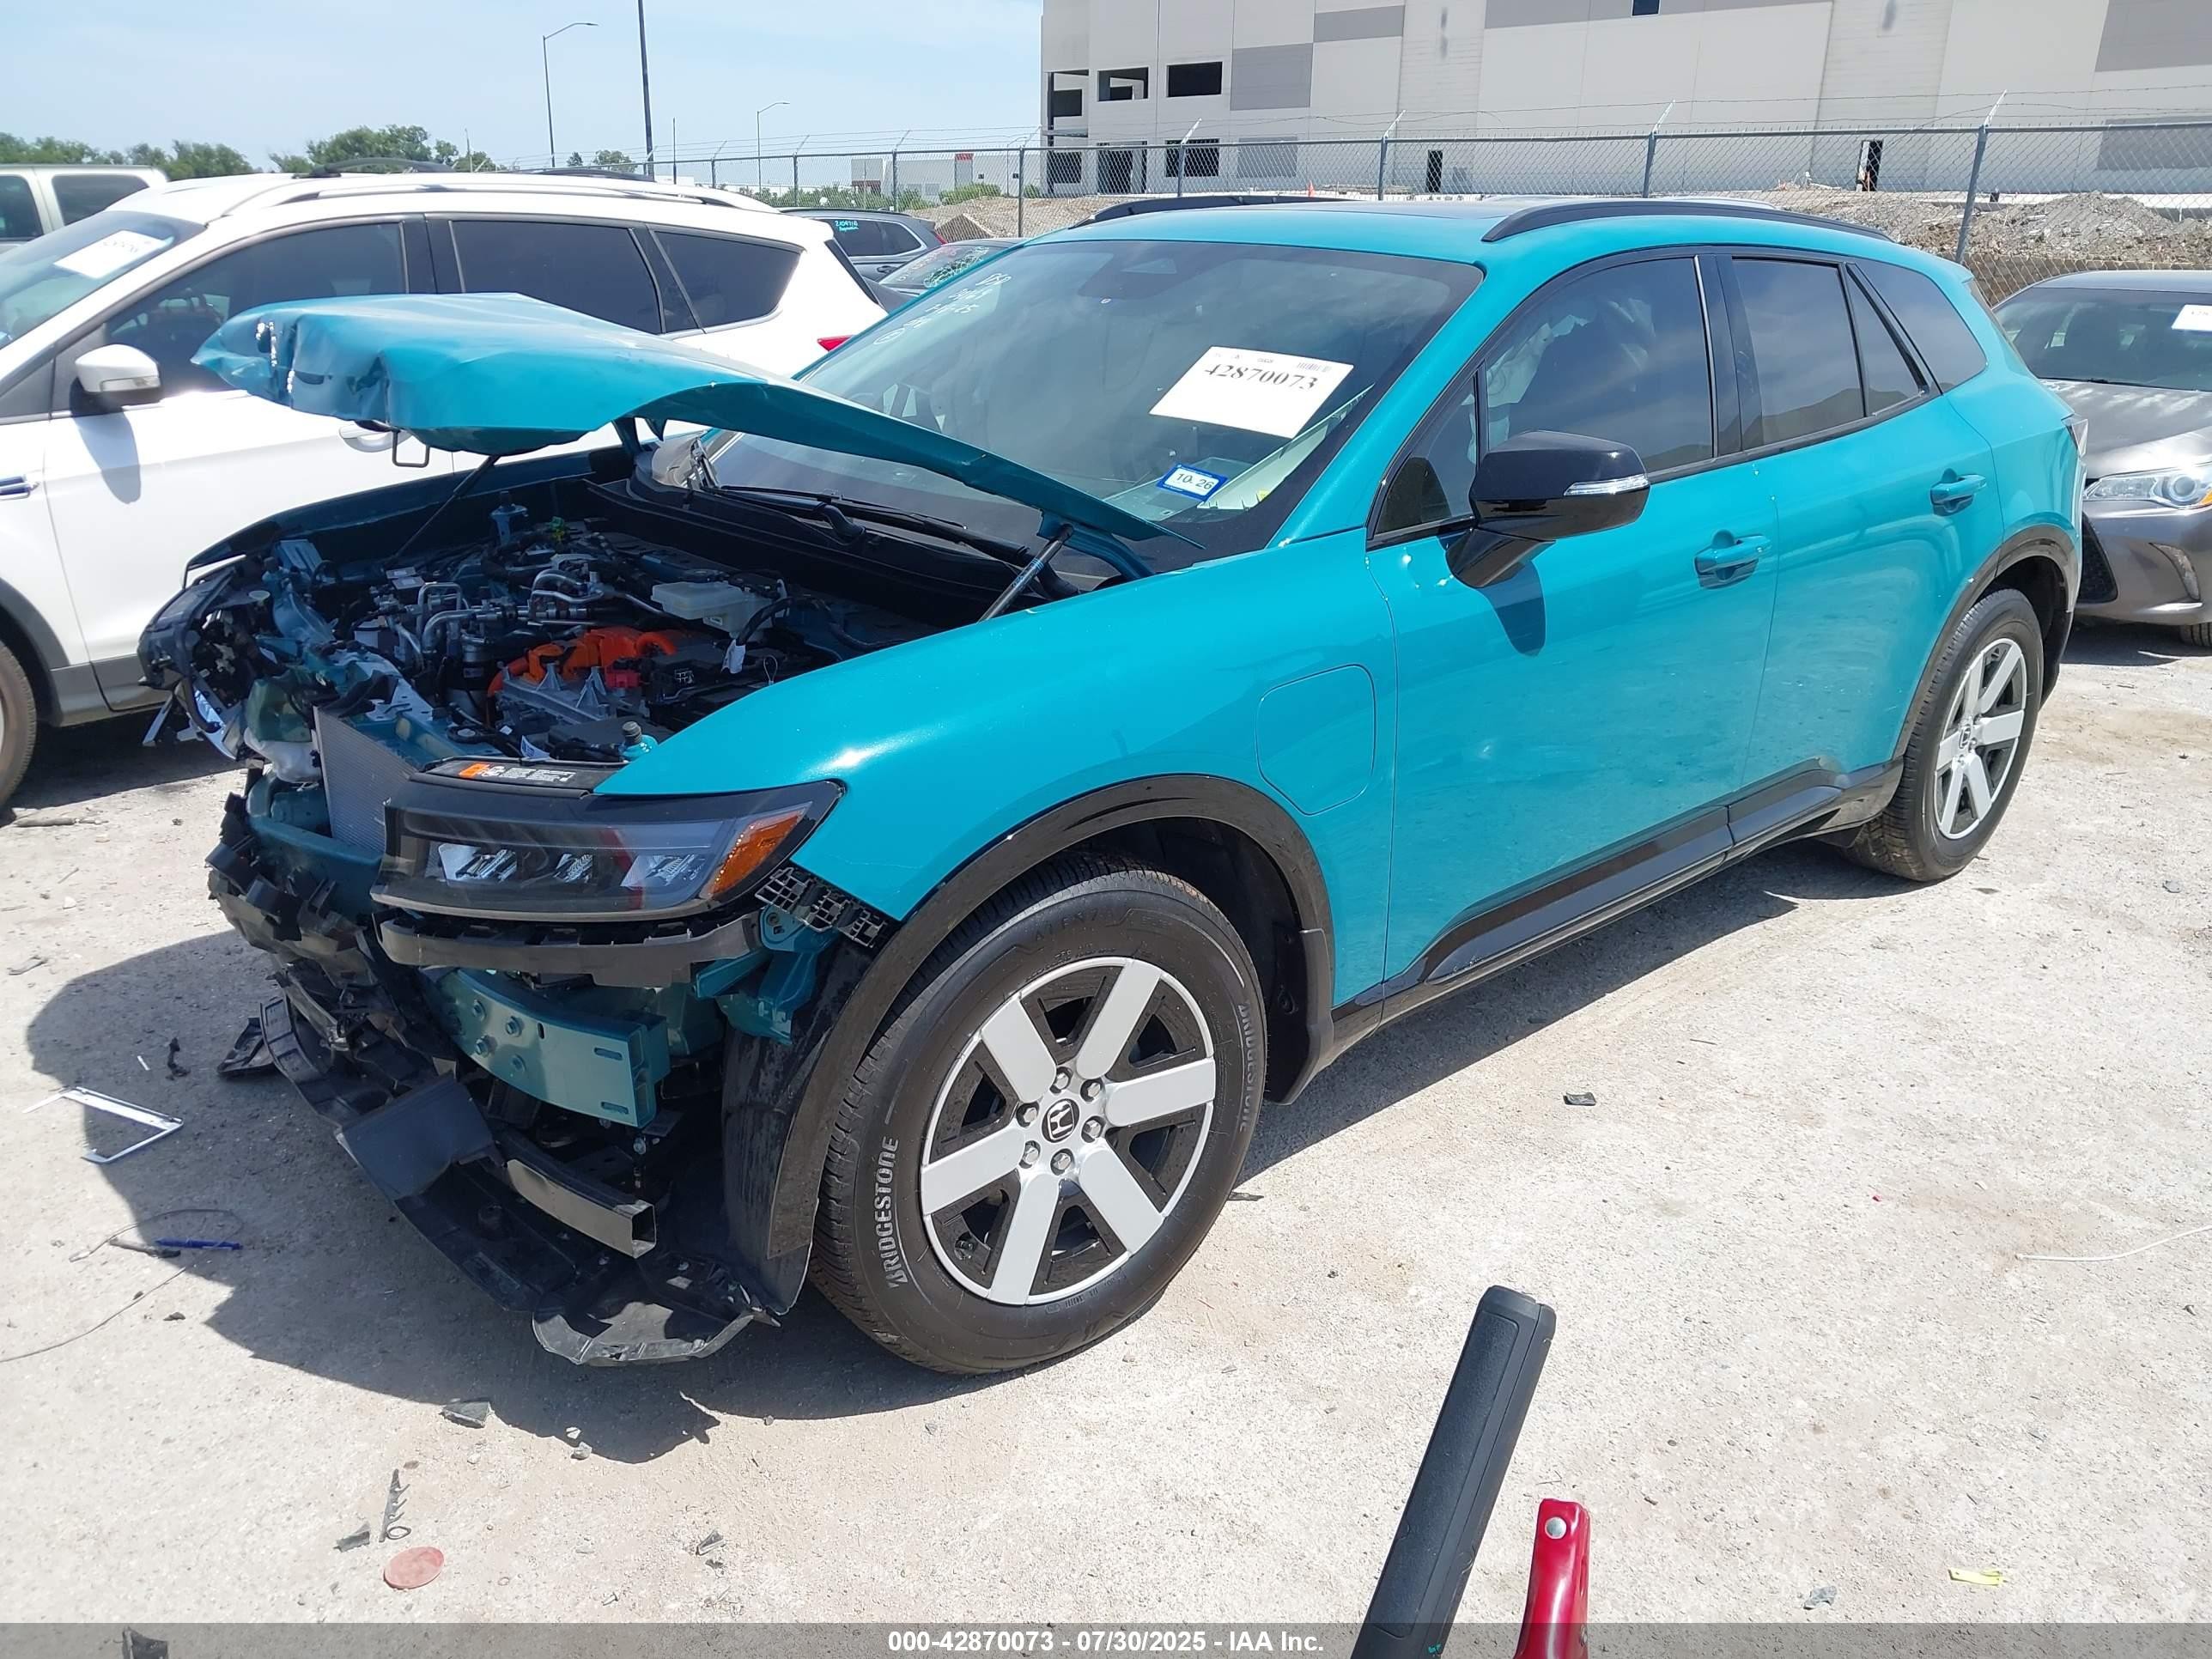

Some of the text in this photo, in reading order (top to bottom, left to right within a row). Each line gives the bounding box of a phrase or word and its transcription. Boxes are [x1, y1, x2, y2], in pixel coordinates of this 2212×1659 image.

[1204, 363, 1318, 390] 42870073
[1195, 479, 1215, 489] 26
[873, 1135, 908, 1289] BRIDGESTONE
